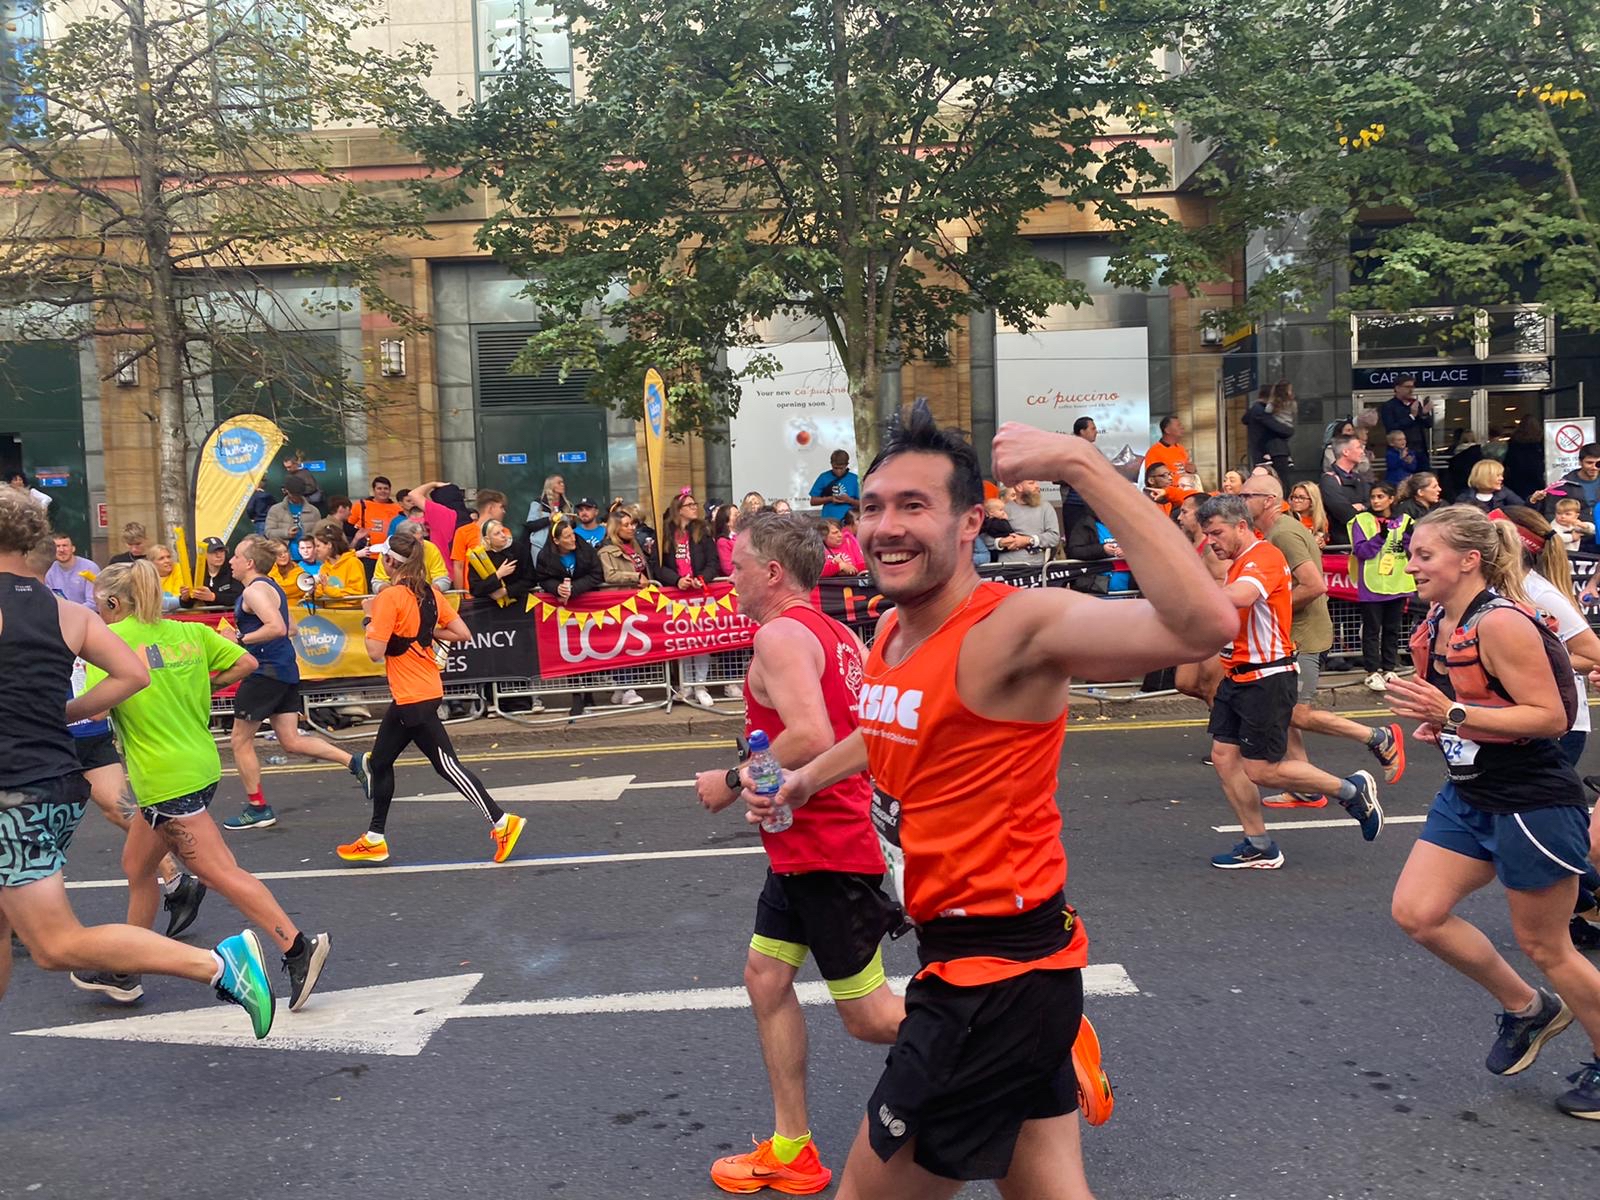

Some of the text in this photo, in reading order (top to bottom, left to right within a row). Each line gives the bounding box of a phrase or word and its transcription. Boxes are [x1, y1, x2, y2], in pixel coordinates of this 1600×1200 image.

[1370, 369, 1468, 384] CABT PLACE
[299, 626, 320, 636] the
[301, 633, 338, 648] lullaby
[664, 630, 751, 653] SERVICES
[305, 644, 330, 656] trust
